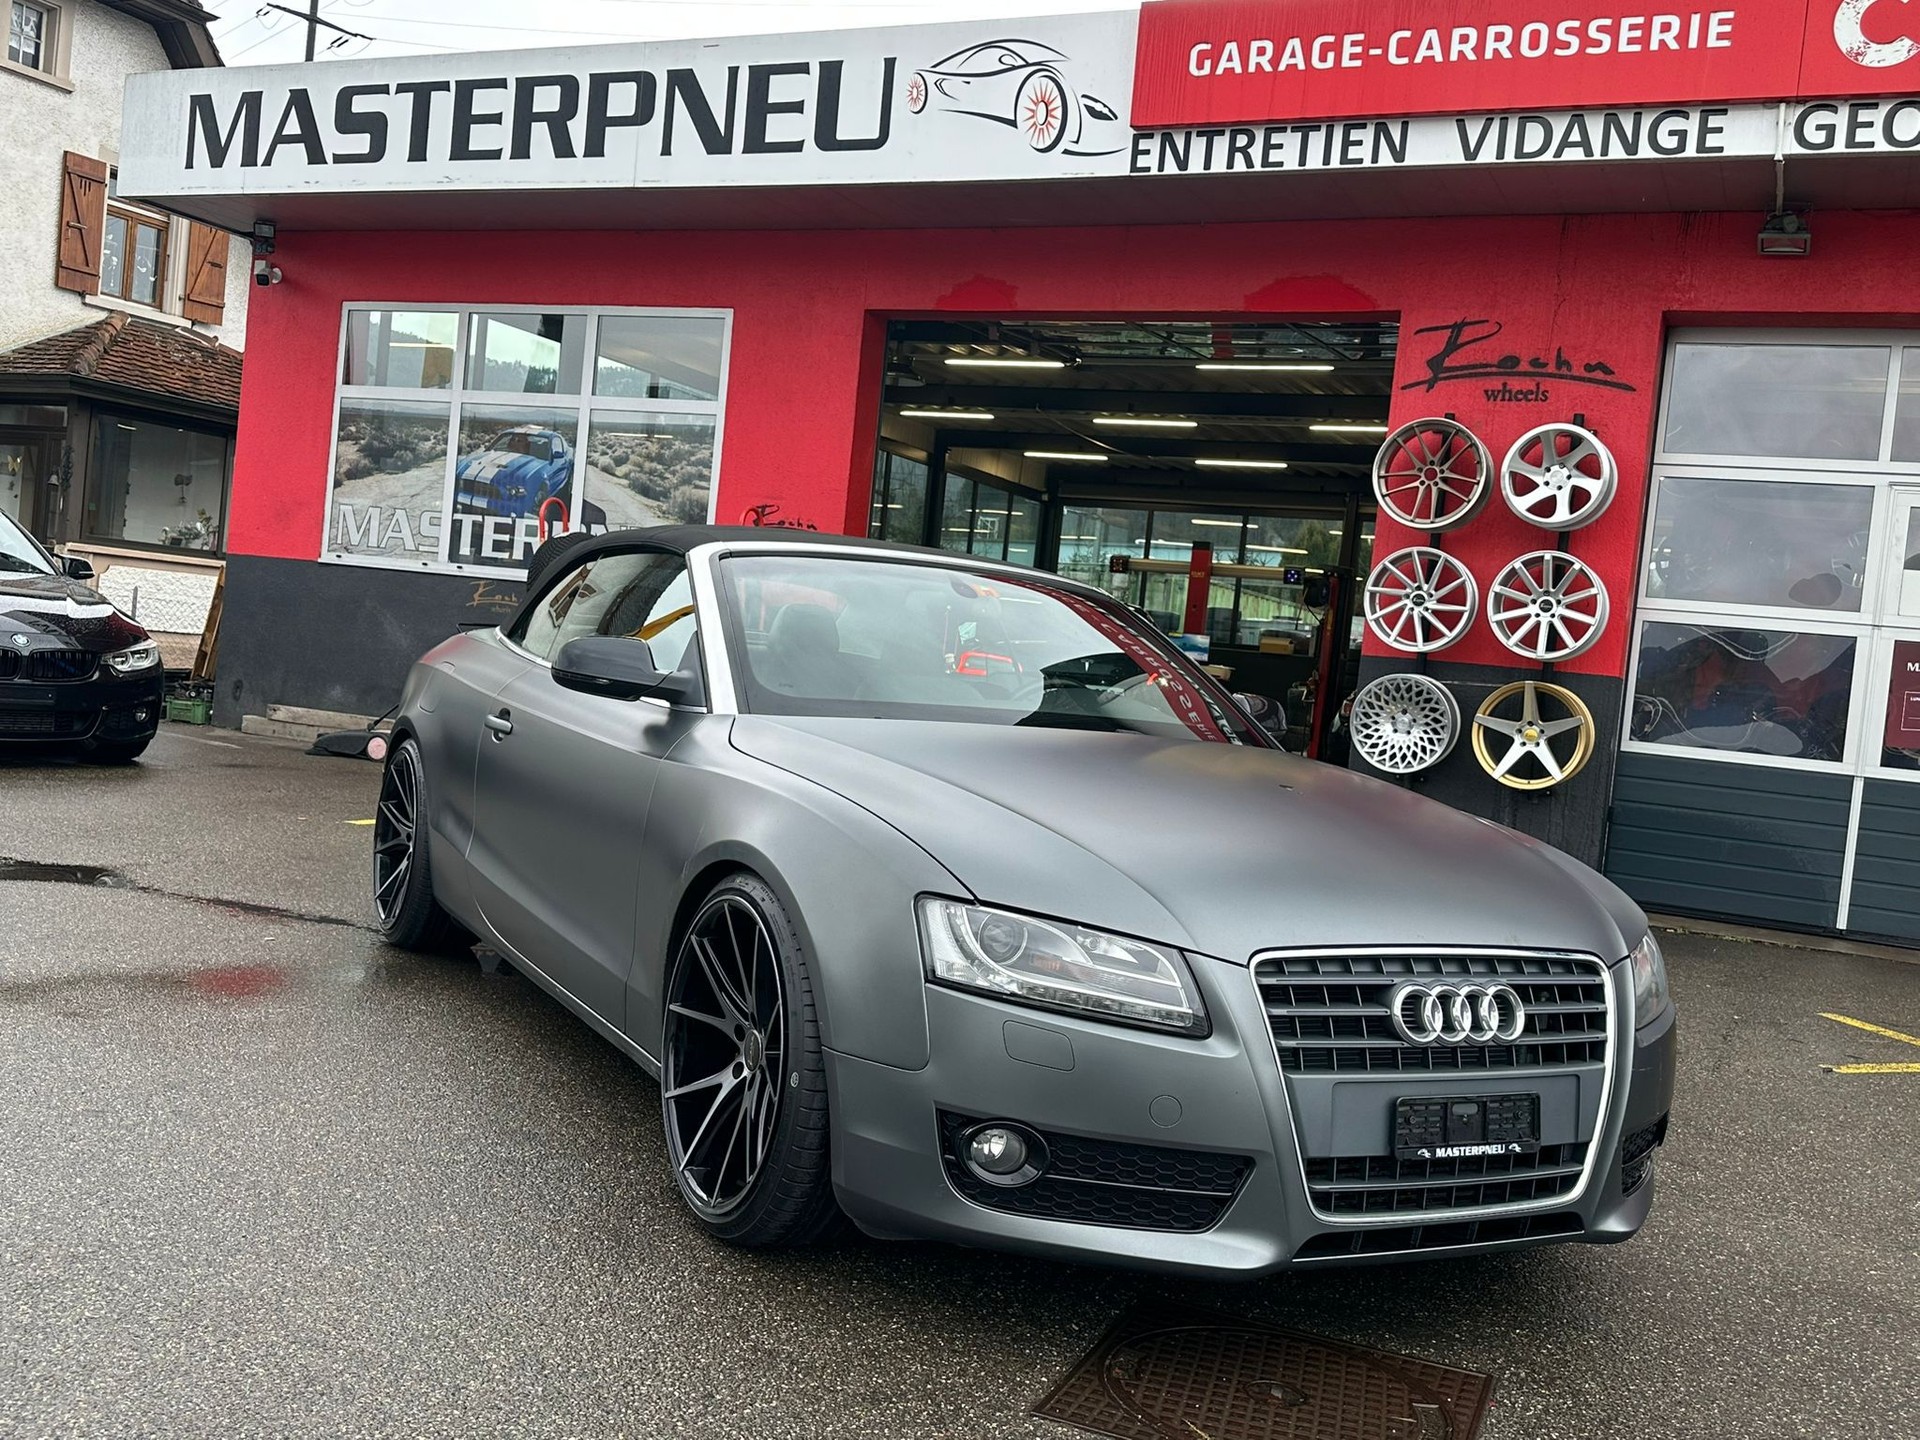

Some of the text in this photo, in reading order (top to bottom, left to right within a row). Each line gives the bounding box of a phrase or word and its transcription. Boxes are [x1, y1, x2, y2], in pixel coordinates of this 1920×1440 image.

[1188, 10, 1736, 77] GARAGE-CARROSSERIE
[184, 56, 898, 169] MASTERPNEU
[1130, 100, 1920, 174] ENTRETIEN VIDANGE GEO
[1484, 382, 1549, 402] wheels
[335, 503, 640, 561] MASTER
[1435, 1145, 1506, 1158] MASTERPNEU
